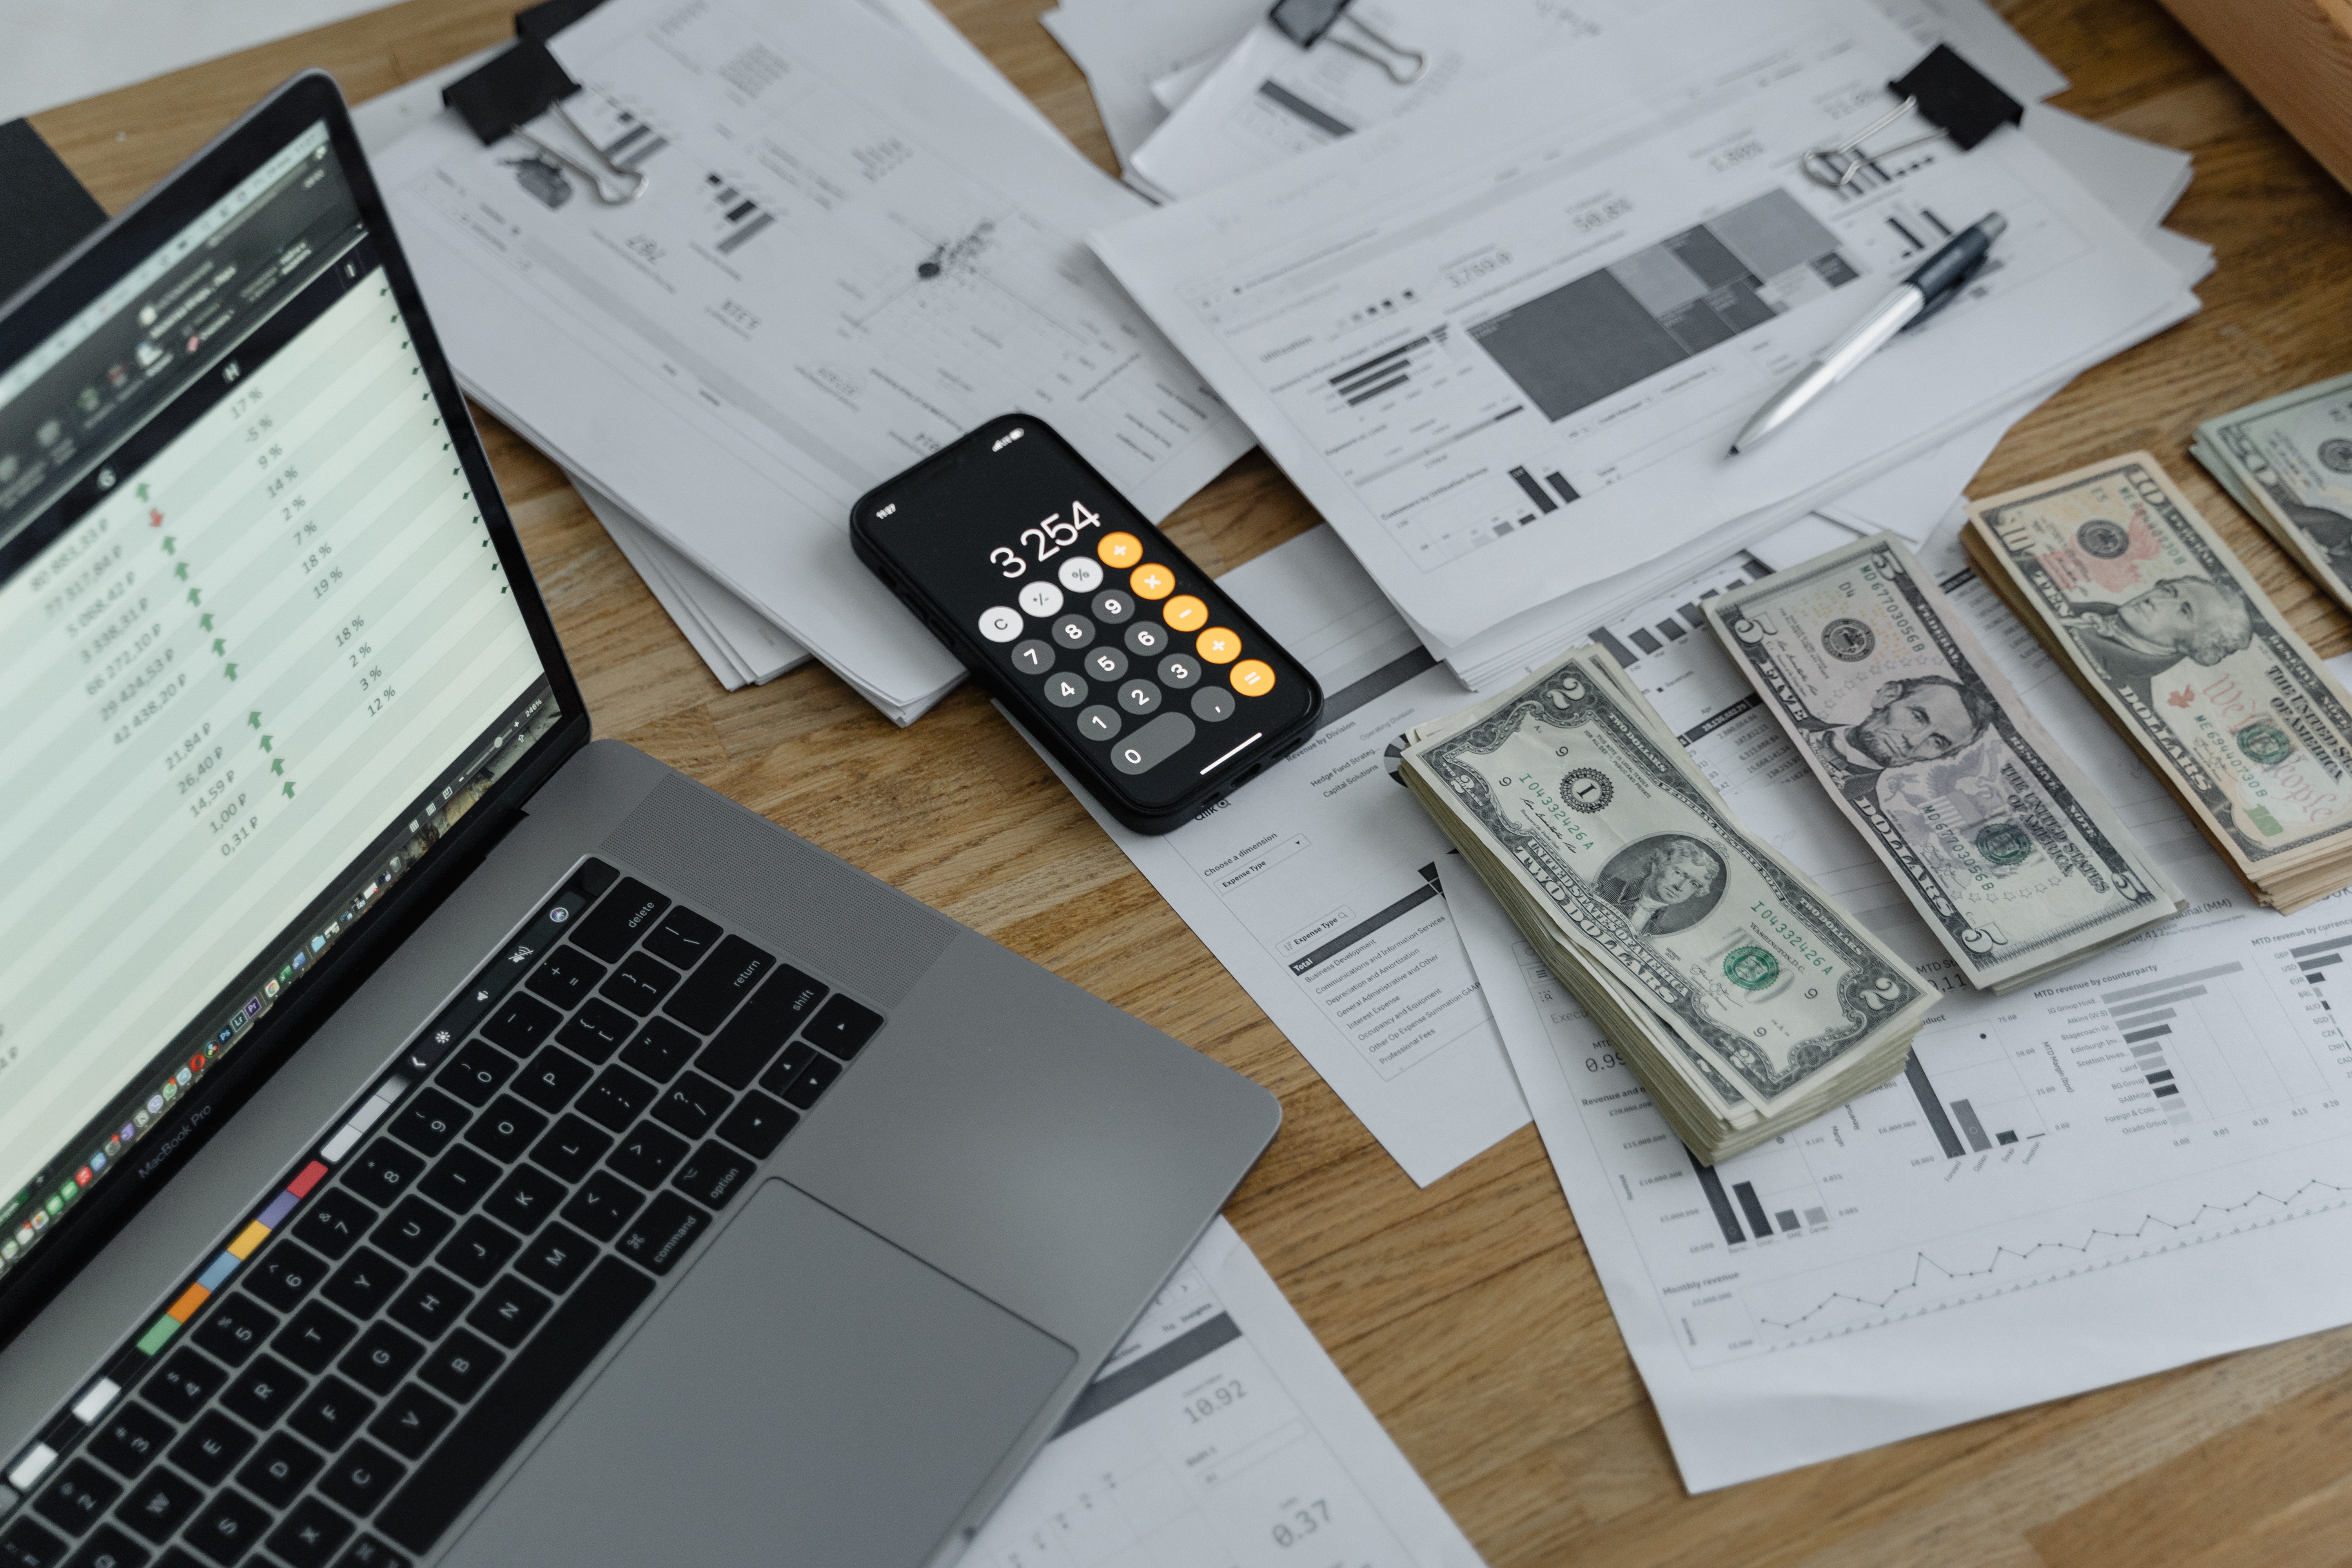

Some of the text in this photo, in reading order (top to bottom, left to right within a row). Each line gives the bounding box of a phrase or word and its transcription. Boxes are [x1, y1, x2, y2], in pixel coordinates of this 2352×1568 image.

[990, 500, 1103, 578] 3 254
[1871, 550, 1905, 581] 5
[336, 615, 365, 647] 18 %
[1023, 599, 1122, 665] 7 8 9
[1061, 631, 1155, 697] 4 5 6
[367, 685, 396, 717] 12 %
[1092, 663, 1188, 729] 1 2 3
[1546, 677, 1586, 710] 2
[1359, 708, 1415, 740] Operating Division
[1125, 749, 1142, 764] 0
[1284, 743, 1317, 762] Revenue
[1325, 721, 1356, 740] Division
[1555, 746, 1569, 757] 9
[1608, 712, 1667, 772] TWO DOLLARS
[2118, 685, 2212, 797] DOLLARS
[1597, 734, 1607, 744] THIS
[1604, 744, 1617, 756] NOTE
[1621, 760, 1633, 773] LEGAL
[1633, 771, 1649, 788] TENDER
[1809, 740, 1837, 776] LINCOLN
[1310, 772, 1334, 787] Hedge
[1332, 762, 1351, 775] Fund
[1323, 764, 1379, 798] Capital Solutions
[1499, 777, 1512, 787] 9
[1758, 659, 1808, 720] FIVE
[1853, 795, 1955, 916] DOLLARS
[1519, 773, 1594, 850] I 04332426 A
[2001, 762, 2110, 893] THE UNITED STATES
[221, 827, 249, 856] 0,31
[1922, 805, 1994, 891] MD 67703056 B
[2008, 794, 2073, 877] OF AMERICA
[1204, 858, 1233, 877] Choose
[1238, 833, 1278, 857] dimension
[1222, 861, 1266, 888] Expense Type
[628, 902, 657, 930] delete
[1294, 918, 1338, 945] Expense Type
[1799, 897, 1864, 955] TWO DOLLARS
[1750, 901, 1833, 976] I 04332426 A
[1961, 921, 2009, 953] 5
[2251, 936, 2271, 946] MTD
[2272, 930, 2306, 942] revenue
[1293, 958, 1313, 971] Total
[1304, 939, 1377, 983] Business Development
[1315, 916, 1446, 994] Communications and Information Services
[2274, 951, 2289, 959] GBP
[2281, 964, 2297, 972] USD
[733, 960, 762, 989] return
[1325, 949, 1420, 1006] Depreciation and Amortization
[1336, 954, 1438, 1017] General Administrative and Other
[2033, 989, 2054, 999] MTD
[2055, 982, 2089, 994] revenue
[2102, 965, 2157, 983] counterparty
[248, 1003, 258, 1012] Pr
[793, 990, 816, 1013] shift
[1858, 977, 1901, 1011] 2
[2056, 1003, 2078, 1012] Group
[2305, 1003, 2321, 1011] AUD
[234, 1016, 243, 1026] Lr
[1347, 996, 1401, 1029] Interest Expense
[1358, 988, 1442, 1041] Occupancy and Equipment
[1368, 980, 1482, 1053] Other Op Expense Summation GAAP
[2067, 1016, 2089, 1024] Atkins
[2089, 1012, 2099, 1020] (W
[220, 1030, 230, 1040] Ps
[1379, 1029, 1436, 1065] Professional Fees
[2060, 1027, 2101, 1041] Stagecoach
[2076, 1056, 2105, 1067] Scottish
[2119, 1063, 2138, 1073] Laird
[542, 1073, 555, 1086] P
[1582, 1085, 1641, 1106] Revenue and
[2123, 1078, 2145, 1087] Group
[138, 1105, 211, 1178] MacBook Pro
[498, 1122, 514, 1134] O
[2122, 1119, 2168, 1134] Ocado Group
[562, 1145, 579, 1155] L
[710, 1168, 739, 1198] option
[654, 1216, 699, 1265] command
[1662, 1272, 1739, 1296] Monthly revenue
